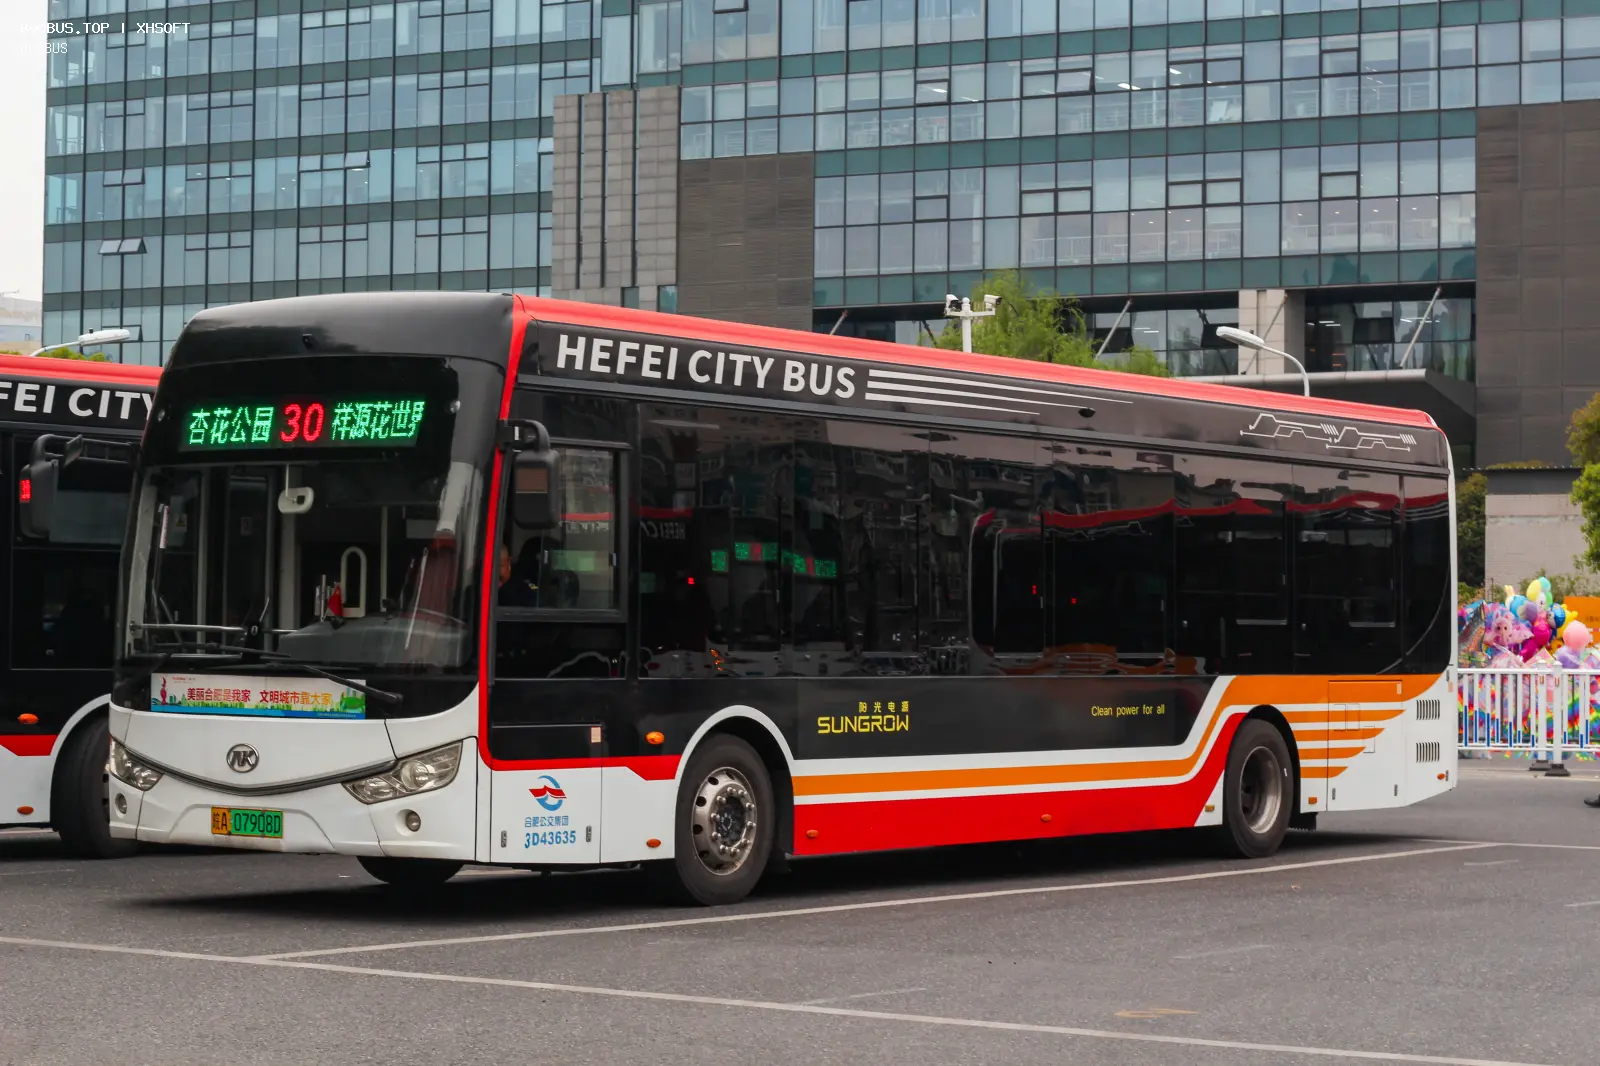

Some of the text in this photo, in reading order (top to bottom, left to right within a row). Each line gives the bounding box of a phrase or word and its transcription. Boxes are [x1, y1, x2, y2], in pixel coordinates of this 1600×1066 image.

[556, 334, 856, 399] HEFEI CITY BUS
[189, 406, 274, 444] 杏花公园
[280, 403, 324, 442] 30
[187, 687, 333, 706] 美丽合肥是我家 文明城市靠大家
[858, 700, 909, 713] 阳光电源
[1091, 703, 1165, 718] Clean power for all
[817, 714, 909, 734] SUNGROW
[234, 812, 281, 834] 07908D
[524, 815, 569, 828] 合肥公交集团
[524, 830, 576, 849] 3D43635
